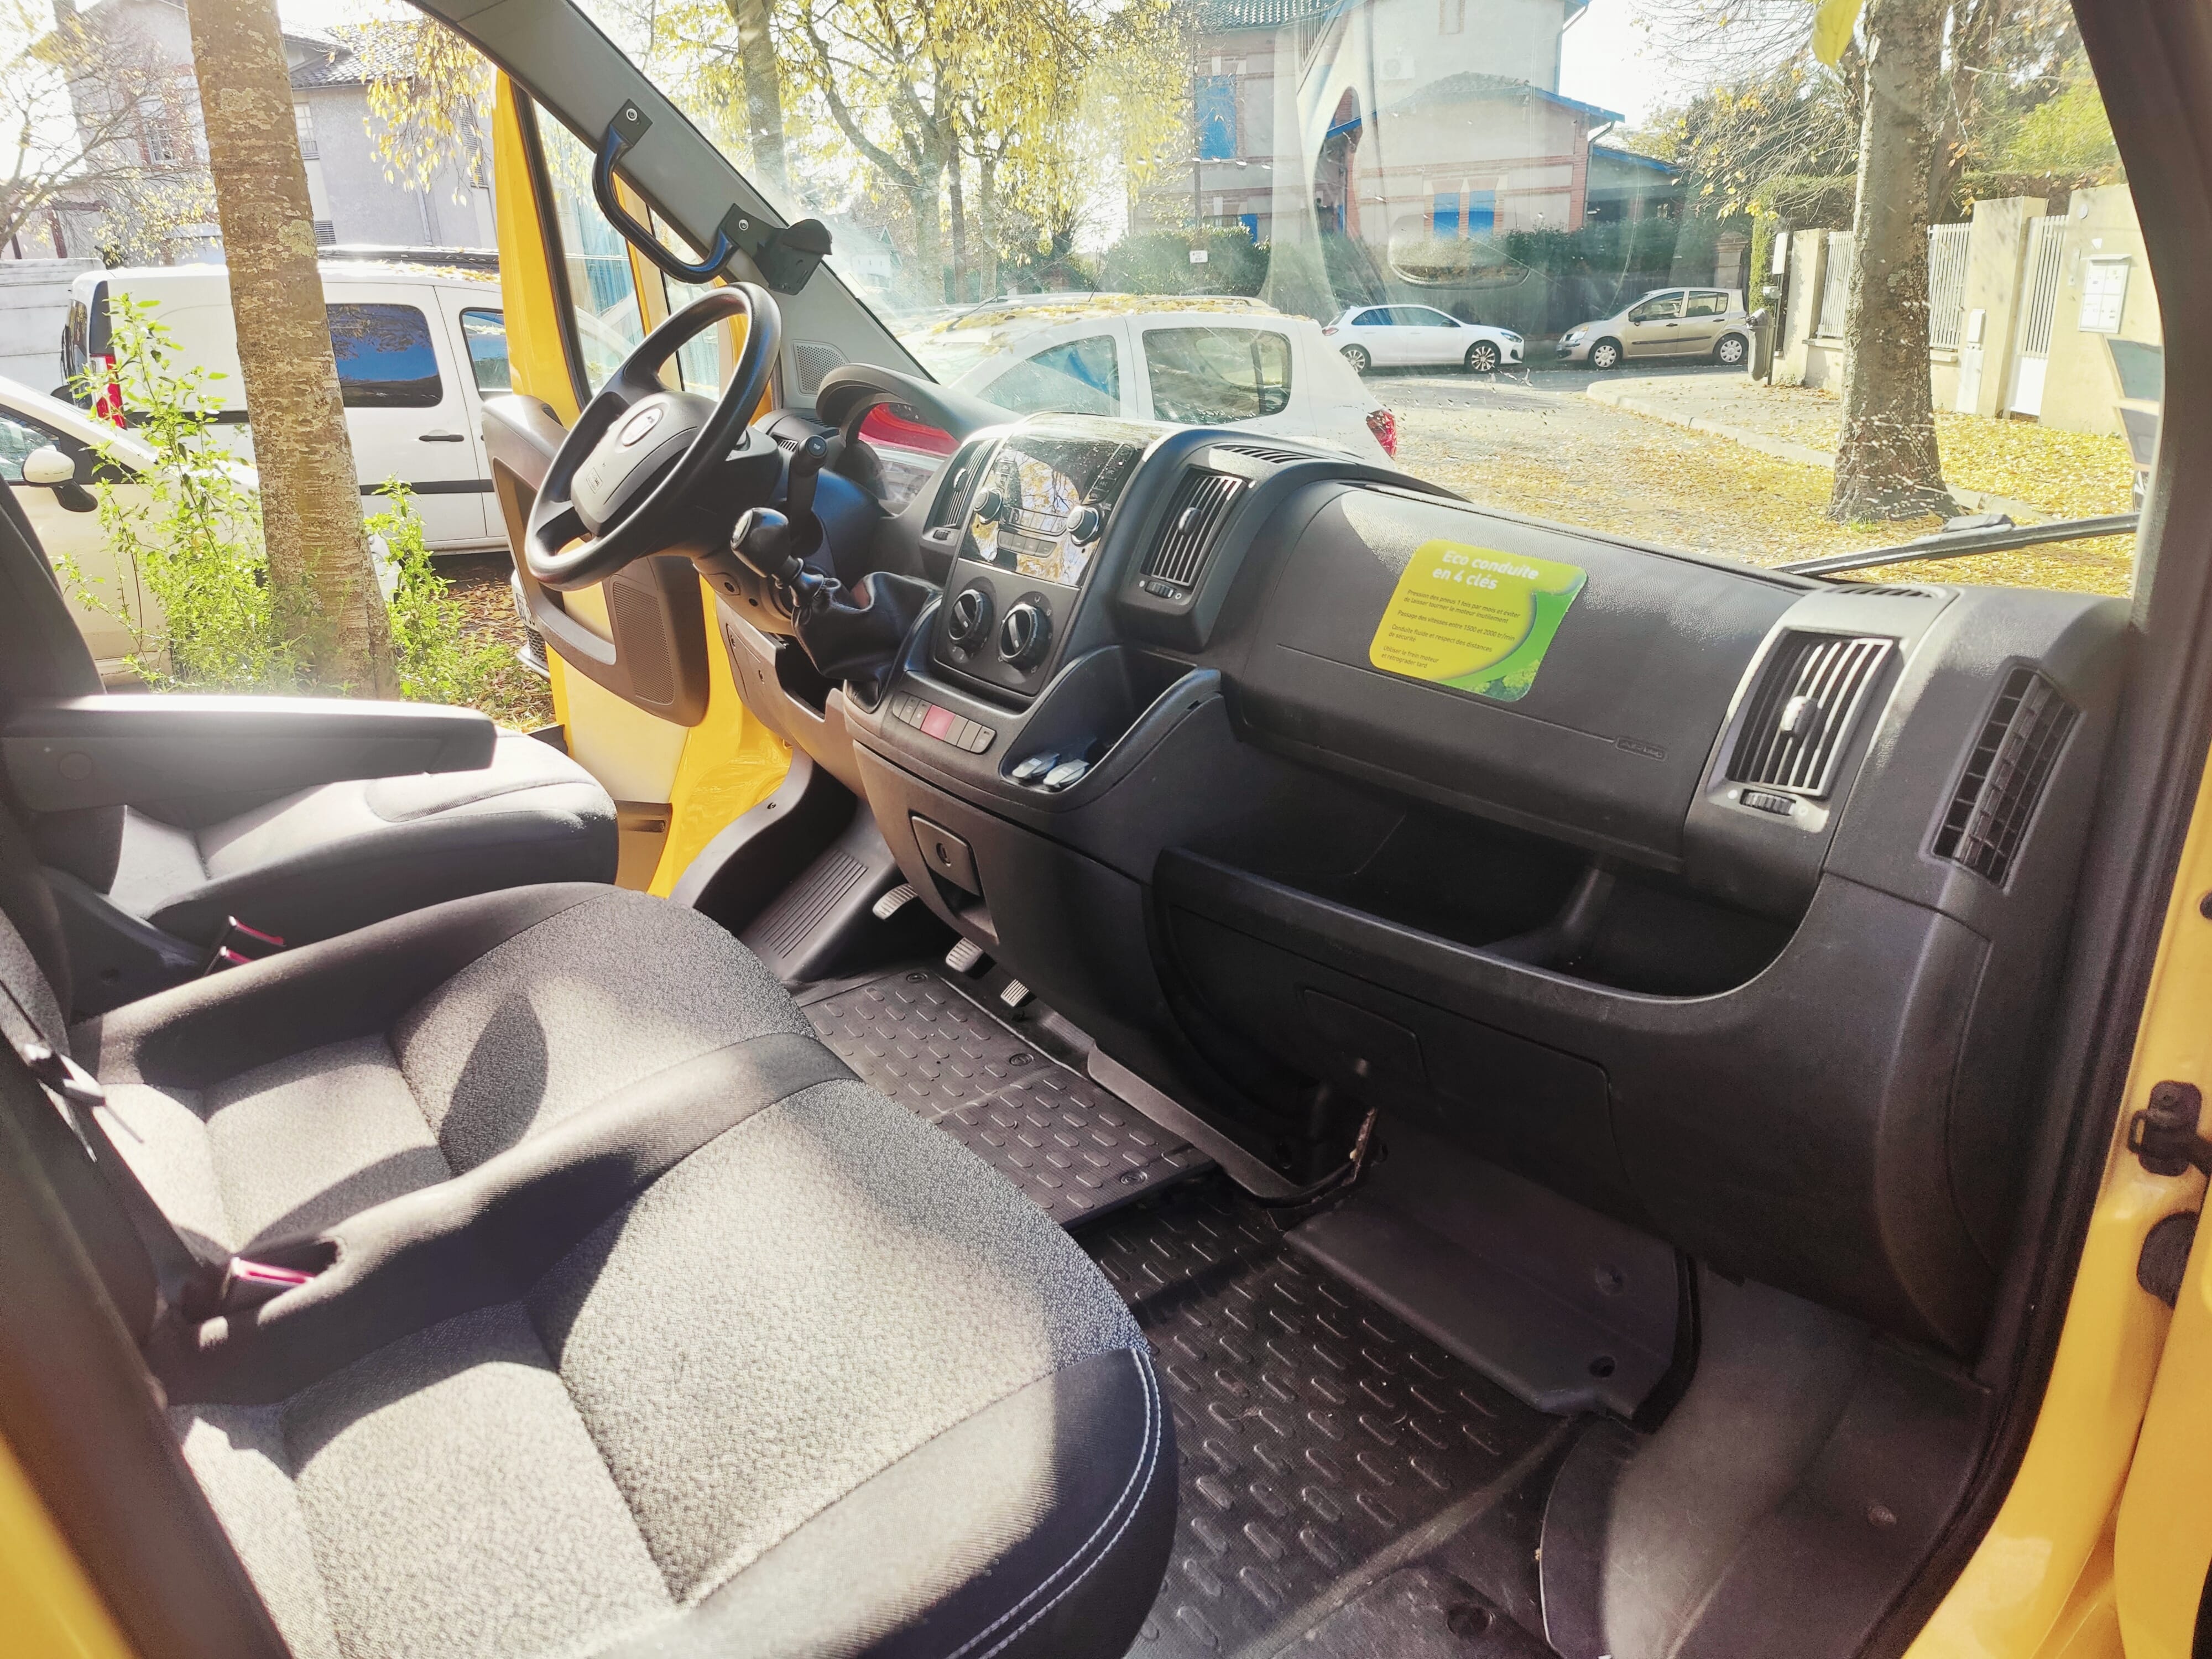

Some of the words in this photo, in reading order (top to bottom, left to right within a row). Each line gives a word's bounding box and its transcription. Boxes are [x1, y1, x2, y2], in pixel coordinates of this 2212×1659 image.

[1442, 550, 1469, 566] Eco
[1472, 559, 1539, 580] conduite
[1433, 568, 1451, 580] en
[1454, 570, 1464, 582] 4
[1466, 573, 1498, 589] clés
[1407, 589, 1429, 599] Pression
[1428, 602, 1449, 610] tourner
[1476, 613, 1509, 624] inutilement
[1397, 610, 1417, 619] Passage
[1427, 617, 1448, 625] vitesses
[1497, 633, 1515, 641] tr/min
[1391, 624, 1413, 633] Conduite
[1413, 629, 1428, 637] fluide
[1435, 635, 1455, 643] respect
[1466, 641, 1492, 652] distances
[1383, 645, 1401, 654] Utiliser
